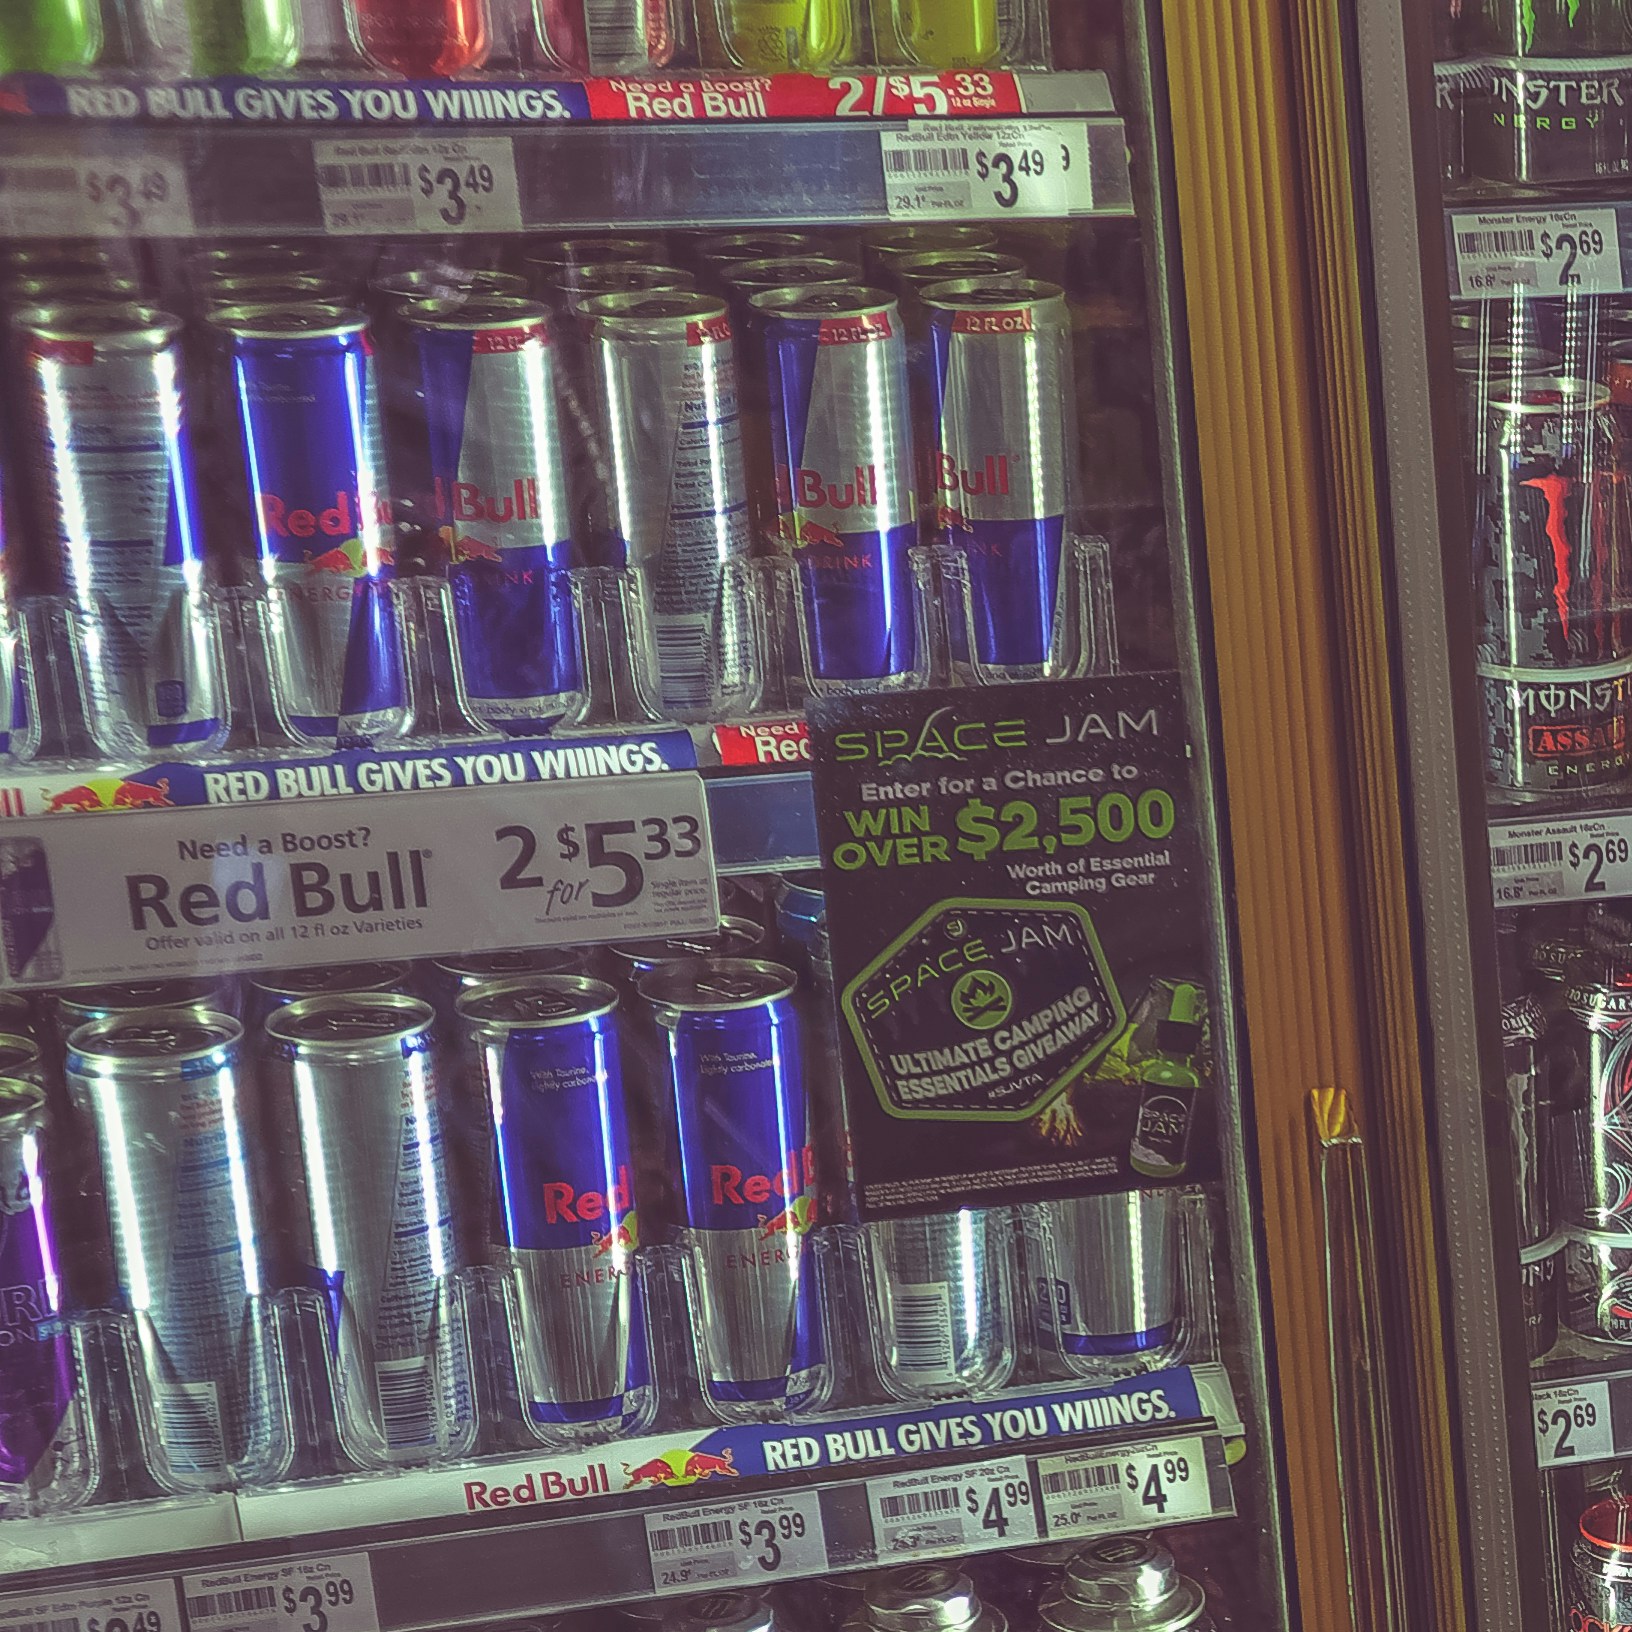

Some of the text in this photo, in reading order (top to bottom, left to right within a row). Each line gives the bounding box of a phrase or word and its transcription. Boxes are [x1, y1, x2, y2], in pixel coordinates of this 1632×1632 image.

[234, 87, 339, 120] GIVES
[338, 88, 417, 120] YOU
[628, 91, 766, 117] Red Bull
[935, 453, 1009, 495] Bull
[453, 479, 539, 526] Bull
[739, 723, 800, 738] Need
[1046, 709, 1159, 744] JAM
[204, 740, 669, 804] RED BULL GIVES YOU WIIINGS.
[861, 763, 1139, 802] Enter for a Chance to
[844, 804, 932, 838] WIN
[956, 788, 1175, 861] $2,500
[176, 826, 371, 862] Need a Boost?
[832, 835, 952, 871] OVER
[494, 824, 544, 890] 2
[546, 875, 589, 916] for
[1006, 850, 1171, 880] Worth of Essential
[1025, 871, 1155, 896] Camping Gear
[125, 849, 429, 931] Red Bull
[145, 931, 190, 952] Offer
[193, 928, 234, 949] valid
[239, 930, 261, 944] on
[264, 924, 286, 941] all
[291, 924, 310, 939] 12
[330, 922, 352, 936] oz
[354, 916, 423, 935] Varieties
[866, 924, 1073, 1020] SPACE JAM
[889, 985, 1092, 1077] ULTIMATE CAMPING
[895, 1002, 1101, 1101] ESSENTIALS GIVEAWAY
[763, 1394, 1176, 1469] RED BULL GIVES YOU WIIINGS.
[464, 1464, 611, 1512] Red Bull
